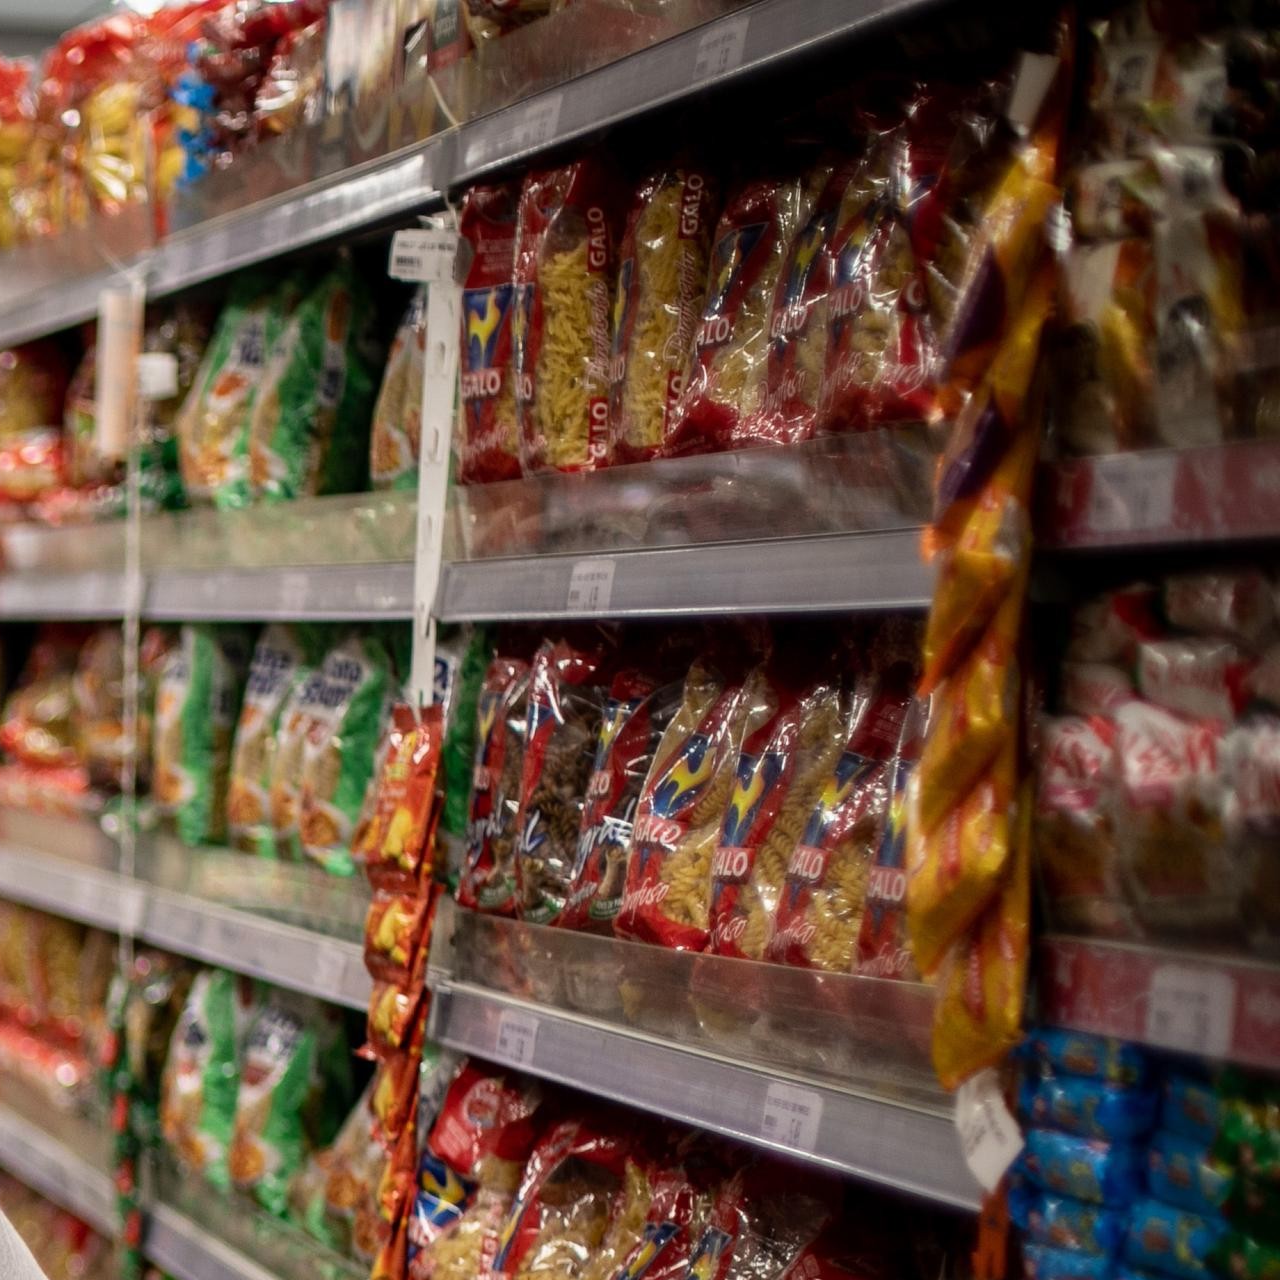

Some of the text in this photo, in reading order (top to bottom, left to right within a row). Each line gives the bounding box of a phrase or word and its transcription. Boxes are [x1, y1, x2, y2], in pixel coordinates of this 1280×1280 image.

[683, 172, 704, 237] GALO
[588, 207, 607, 267] GALO
[831, 286, 863, 318] ALO
[696, 317, 730, 347] ALO
[461, 372, 502, 397] GALO
[591, 402, 608, 459] GALO
[635, 819, 682, 845] GALO
